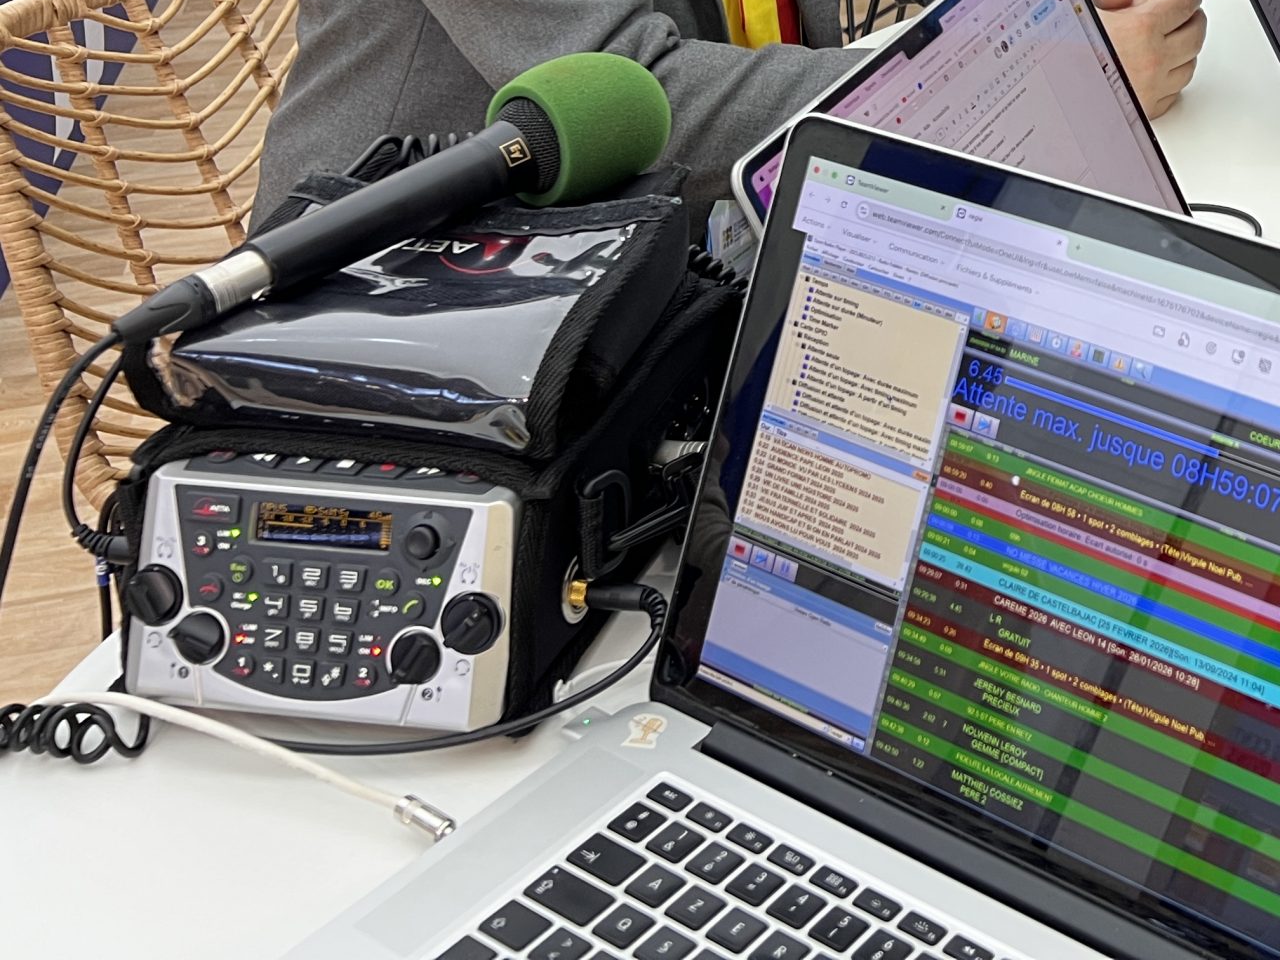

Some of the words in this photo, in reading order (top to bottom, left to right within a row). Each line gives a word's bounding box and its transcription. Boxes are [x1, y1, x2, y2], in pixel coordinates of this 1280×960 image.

[801, 215, 825, 229] Actions
[841, 227, 871, 244] Visualiser
[887, 241, 939, 265] Communication
[1008, 347, 1040, 367] MARINE
[952, 375, 1030, 422] Attente
[1030, 406, 1085, 443] max.
[1086, 422, 1168, 477] jusque
[1040, 497, 1050, 509] de
[1087, 516, 1104, 530] spot
[1109, 525, 1115, 533] 2
[1115, 527, 1155, 550] comblages
[1019, 550, 1048, 570] MESSE
[1047, 561, 1090, 587] VACANCES
[993, 594, 1028, 617] CAREME
[1028, 608, 1048, 625] 2026
[1049, 617, 1071, 634] AVEC
[1072, 627, 1096, 645] LEON
[1096, 637, 1106, 649] 14
[998, 577, 1026, 595] CLAIRE
[1027, 589, 1040, 601] DE
[1040, 594, 1097, 626] CASTELBAJAC
[1111, 622, 1148, 646] FEVRIER
[997, 627, 1031, 649] GRATUIT
[1003, 648, 1013, 659] de
[1050, 668, 1067, 682] spot
[1072, 677, 1078, 686] 2
[1078, 679, 1118, 704] comblages
[973, 676, 1005, 698] JEREMY
[1004, 690, 1042, 714] BESNARD
[981, 691, 1020, 716] PRECIEUX
[962, 723, 1000, 747] NOLWENN
[1000, 740, 1027, 759] LEROY
[970, 738, 1000, 760] GEMME
[999, 752, 1044, 782] [COMPACT]
[951, 769, 989, 794] MATTHIEU
[989, 786, 1024, 811] COSSIEZ
[959, 784, 981, 802] PERE
[980, 794, 987, 805] 2
[649, 878, 663, 890] A
[688, 899, 704, 913] Z
[616, 918, 632, 932] Q
[730, 922, 745, 935] E
[657, 941, 673, 953] S
[774, 946, 787, 958] R
